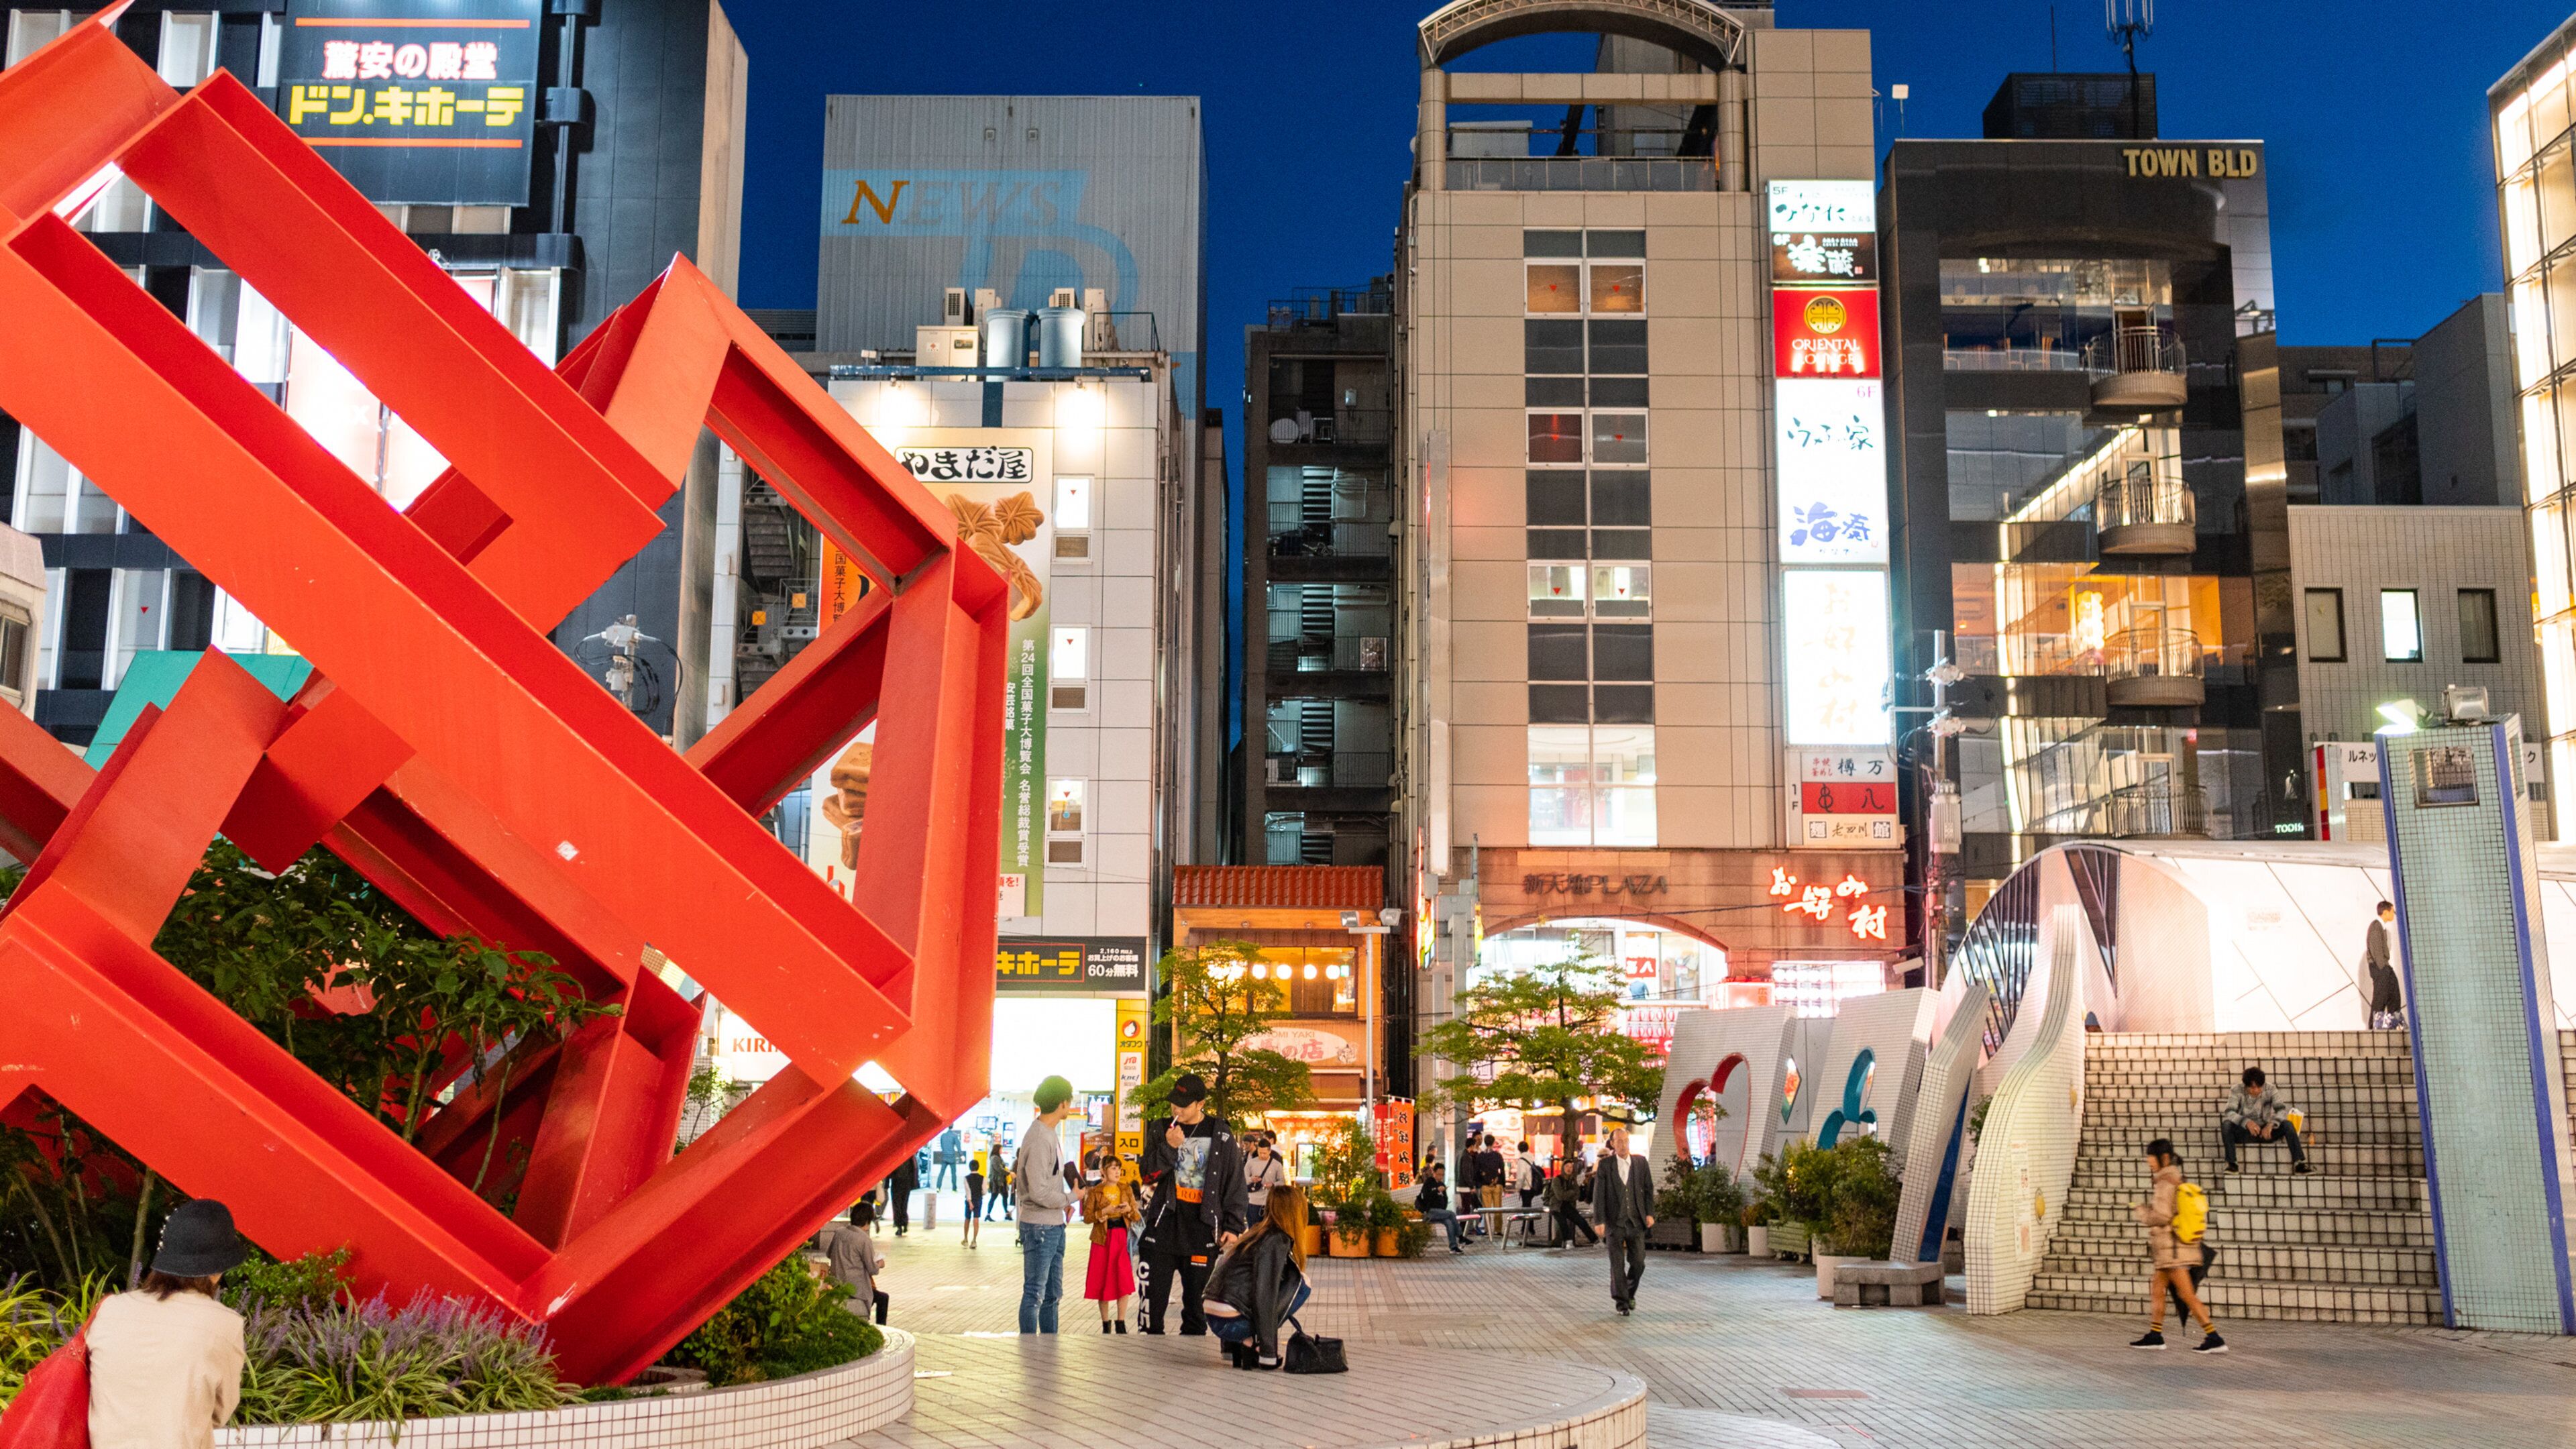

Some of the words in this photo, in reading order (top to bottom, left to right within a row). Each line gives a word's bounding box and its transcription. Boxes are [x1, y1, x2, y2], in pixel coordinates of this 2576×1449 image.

[322, 40, 497, 80] 驚安の殿堂
[2123, 149, 2198, 178] TOWN
[2208, 150, 2257, 178] BLD
[841, 180, 1060, 227] NEWS
[1773, 186, 1788, 195] 5F
[1792, 338, 1860, 352] ORIENTAL
[1857, 385, 1877, 398] 6F
[901, 445, 1028, 480] やまだ屋
[833, 550, 847, 623] 国菓子大博
[1018, 639, 1035, 775] 第24回全国菓子大博覧会
[1523, 873, 1667, 895] 新天地PLAZA
[1770, 866, 1888, 939] お好み村
[1087, 963, 1138, 977] 60分無料
[1119, 1138, 1138, 1148] 入口
